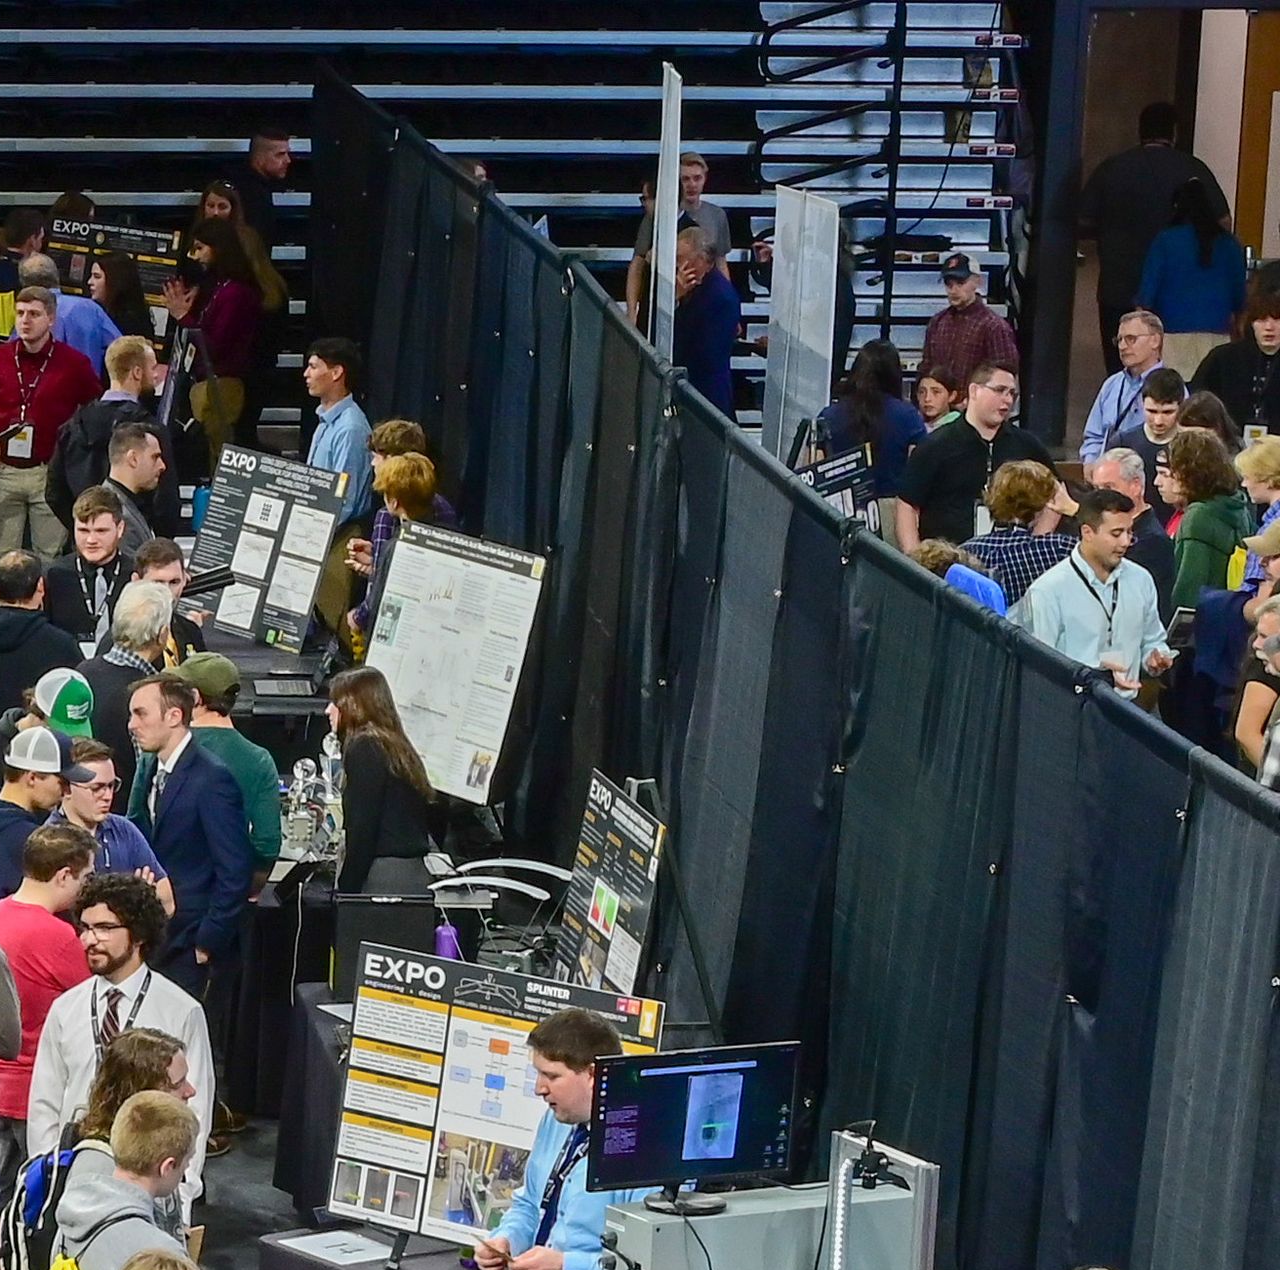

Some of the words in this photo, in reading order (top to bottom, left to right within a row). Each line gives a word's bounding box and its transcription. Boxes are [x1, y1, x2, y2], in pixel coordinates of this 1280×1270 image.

[52, 219, 90, 236] EXPO
[221, 449, 257, 472] EXPO
[589, 778, 612, 811] EXPO
[364, 953, 446, 990] EXPO
[364, 978, 405, 993] engineering
[418, 988, 442, 1000] design
[526, 981, 571, 1001] SPLINTER
